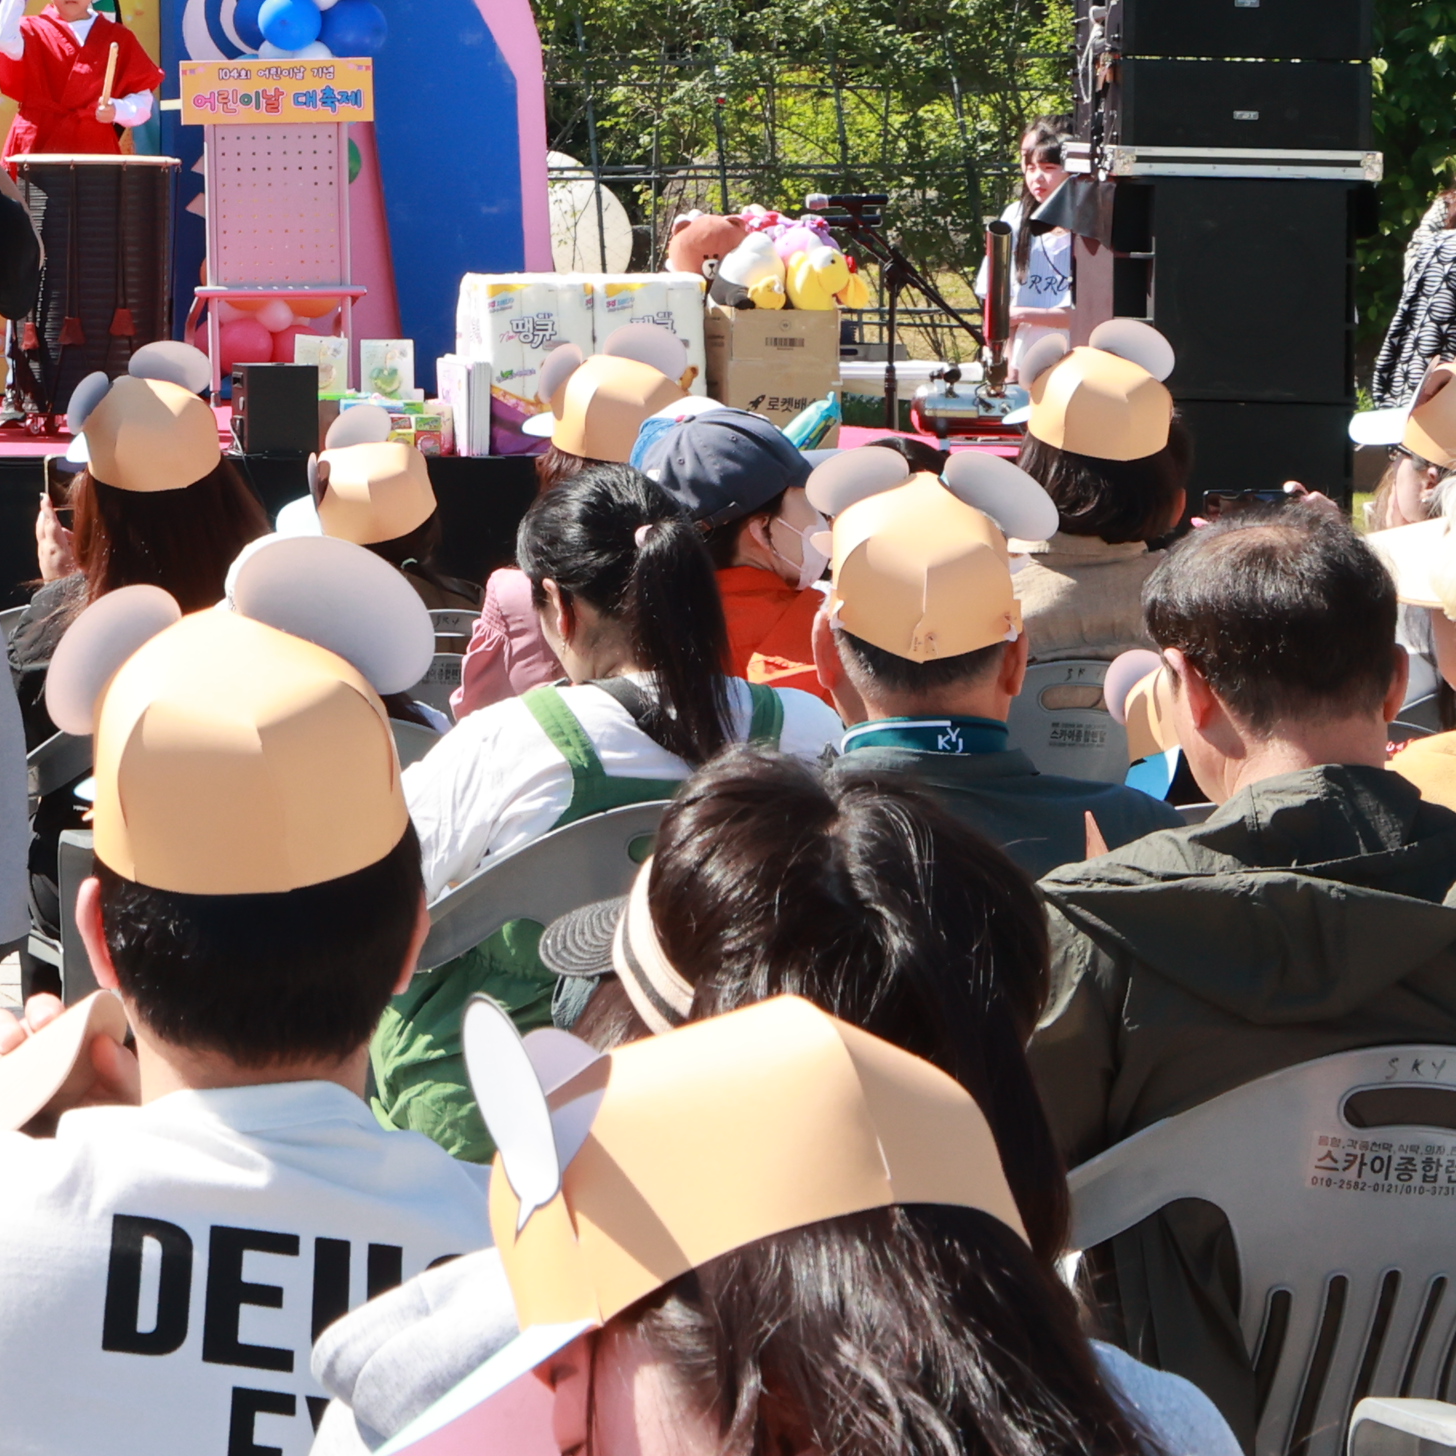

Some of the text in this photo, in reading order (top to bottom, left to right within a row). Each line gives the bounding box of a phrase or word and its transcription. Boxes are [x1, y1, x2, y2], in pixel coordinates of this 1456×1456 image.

[217, 65, 335, 81] 104회 어린이날 기념
[192, 84, 365, 115] 어린이날 대축제
[510, 316, 557, 350] 땡큐
[766, 396, 817, 413] 로켓배
[1384, 1057, 1447, 1080] SKY
[102, 1213, 465, 1374] DEU
[228, 1386, 332, 1456] E
